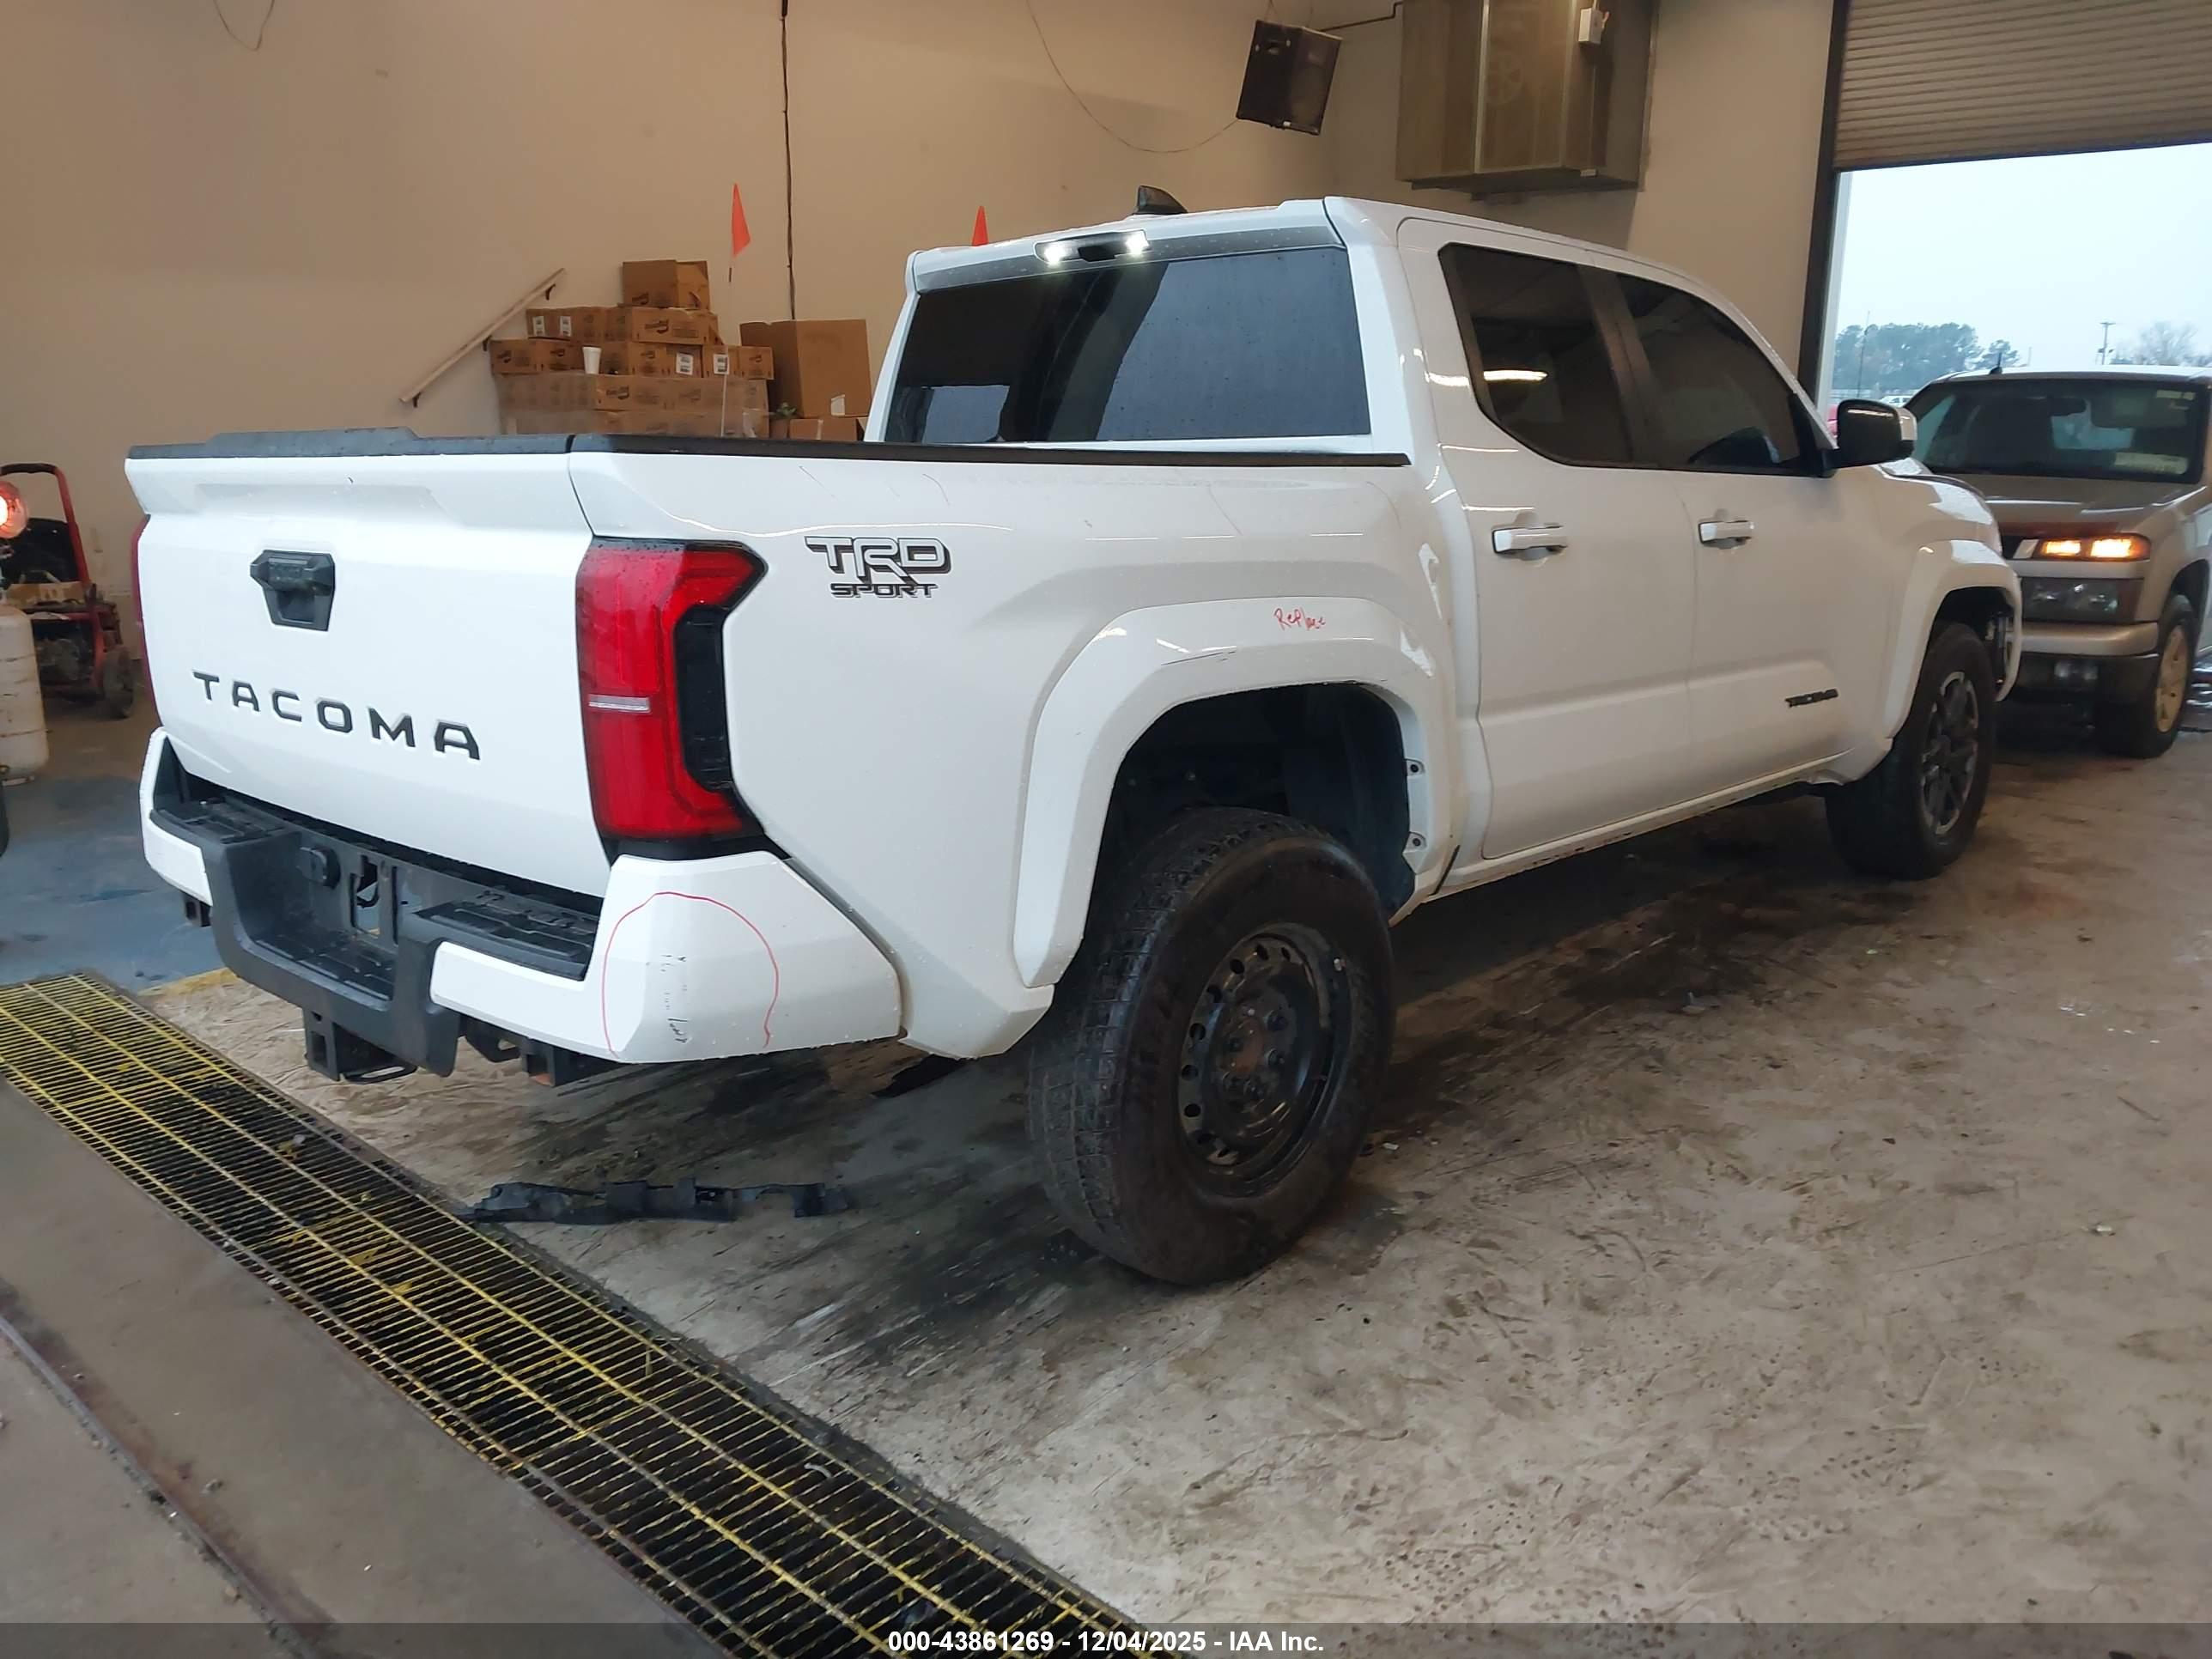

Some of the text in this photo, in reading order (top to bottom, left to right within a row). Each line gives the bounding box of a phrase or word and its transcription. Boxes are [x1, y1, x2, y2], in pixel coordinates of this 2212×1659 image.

[804, 536, 951, 585] TRD
[830, 583, 939, 599] SPORT
[192, 670, 481, 761] TACOMA
